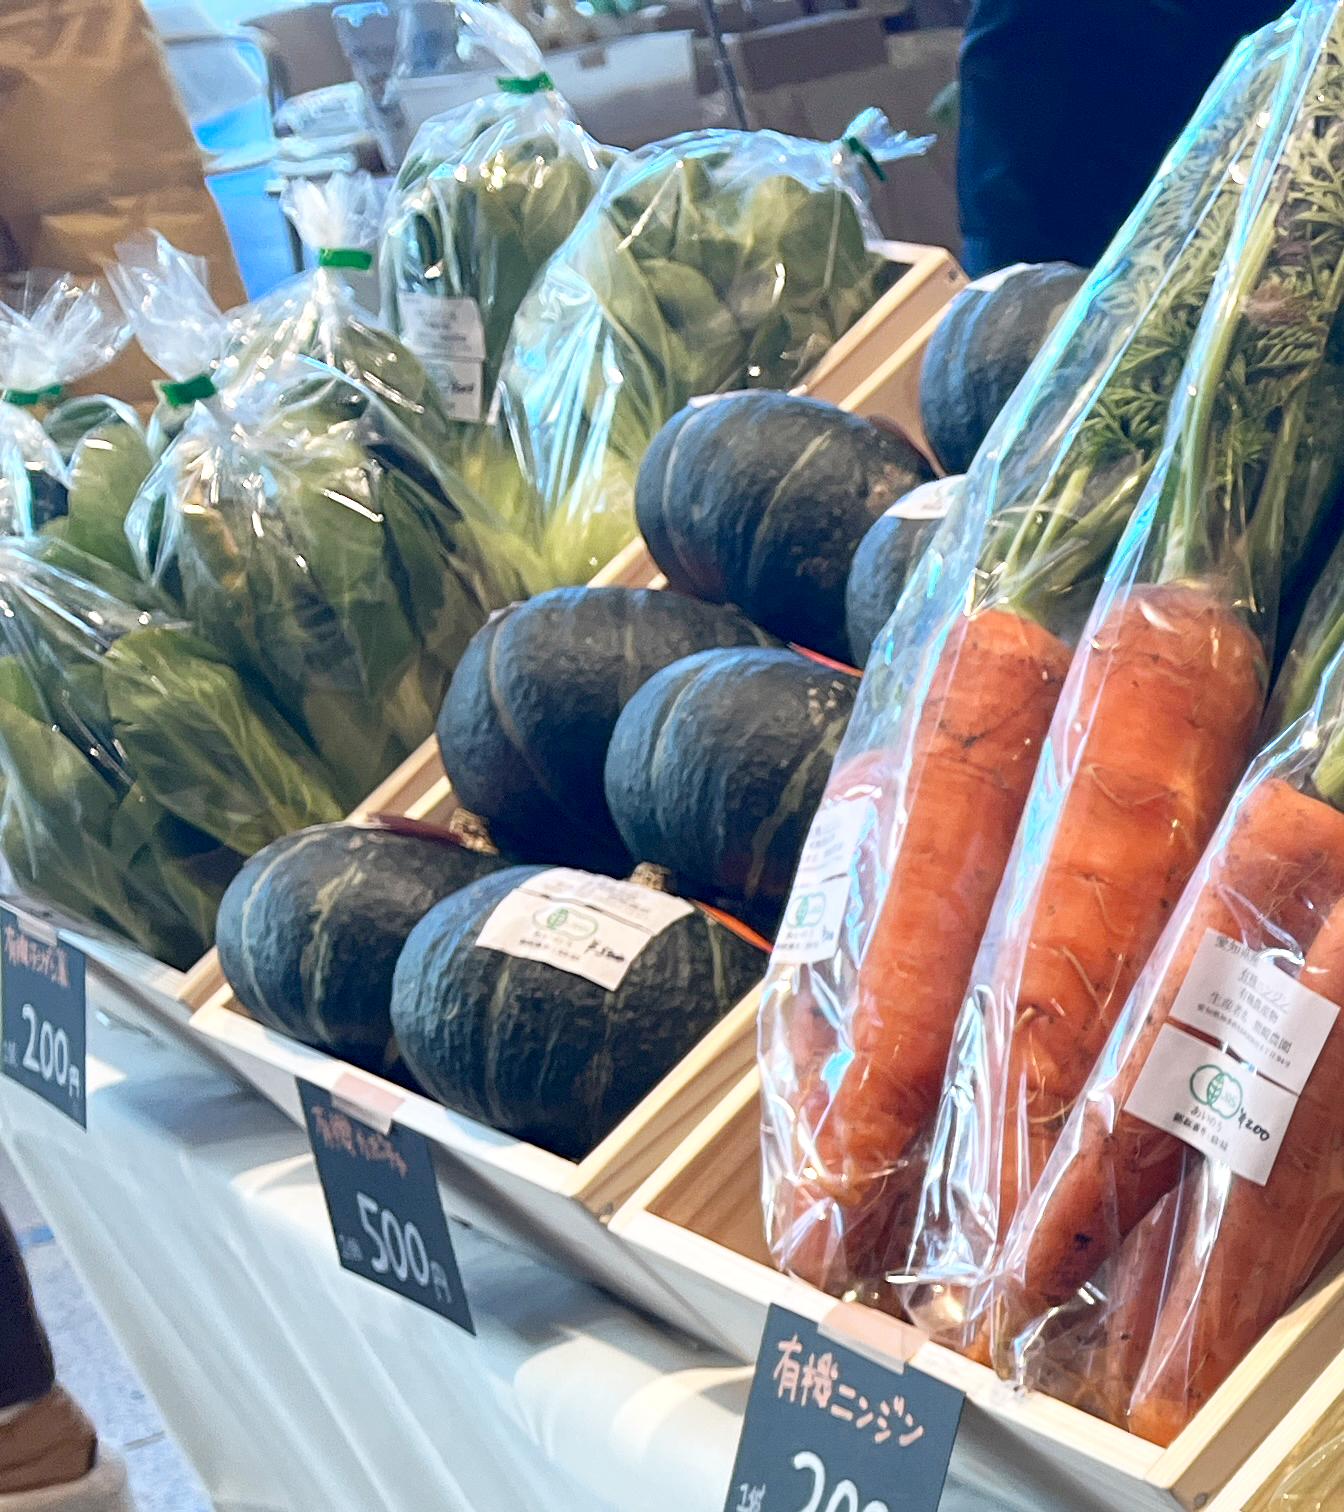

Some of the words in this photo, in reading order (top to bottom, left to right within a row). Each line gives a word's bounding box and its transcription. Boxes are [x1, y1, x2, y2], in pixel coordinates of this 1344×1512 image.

[1237, 1107, 1271, 1142] ¥200
[772, 1333, 925, 1449] 有機ニンジン
